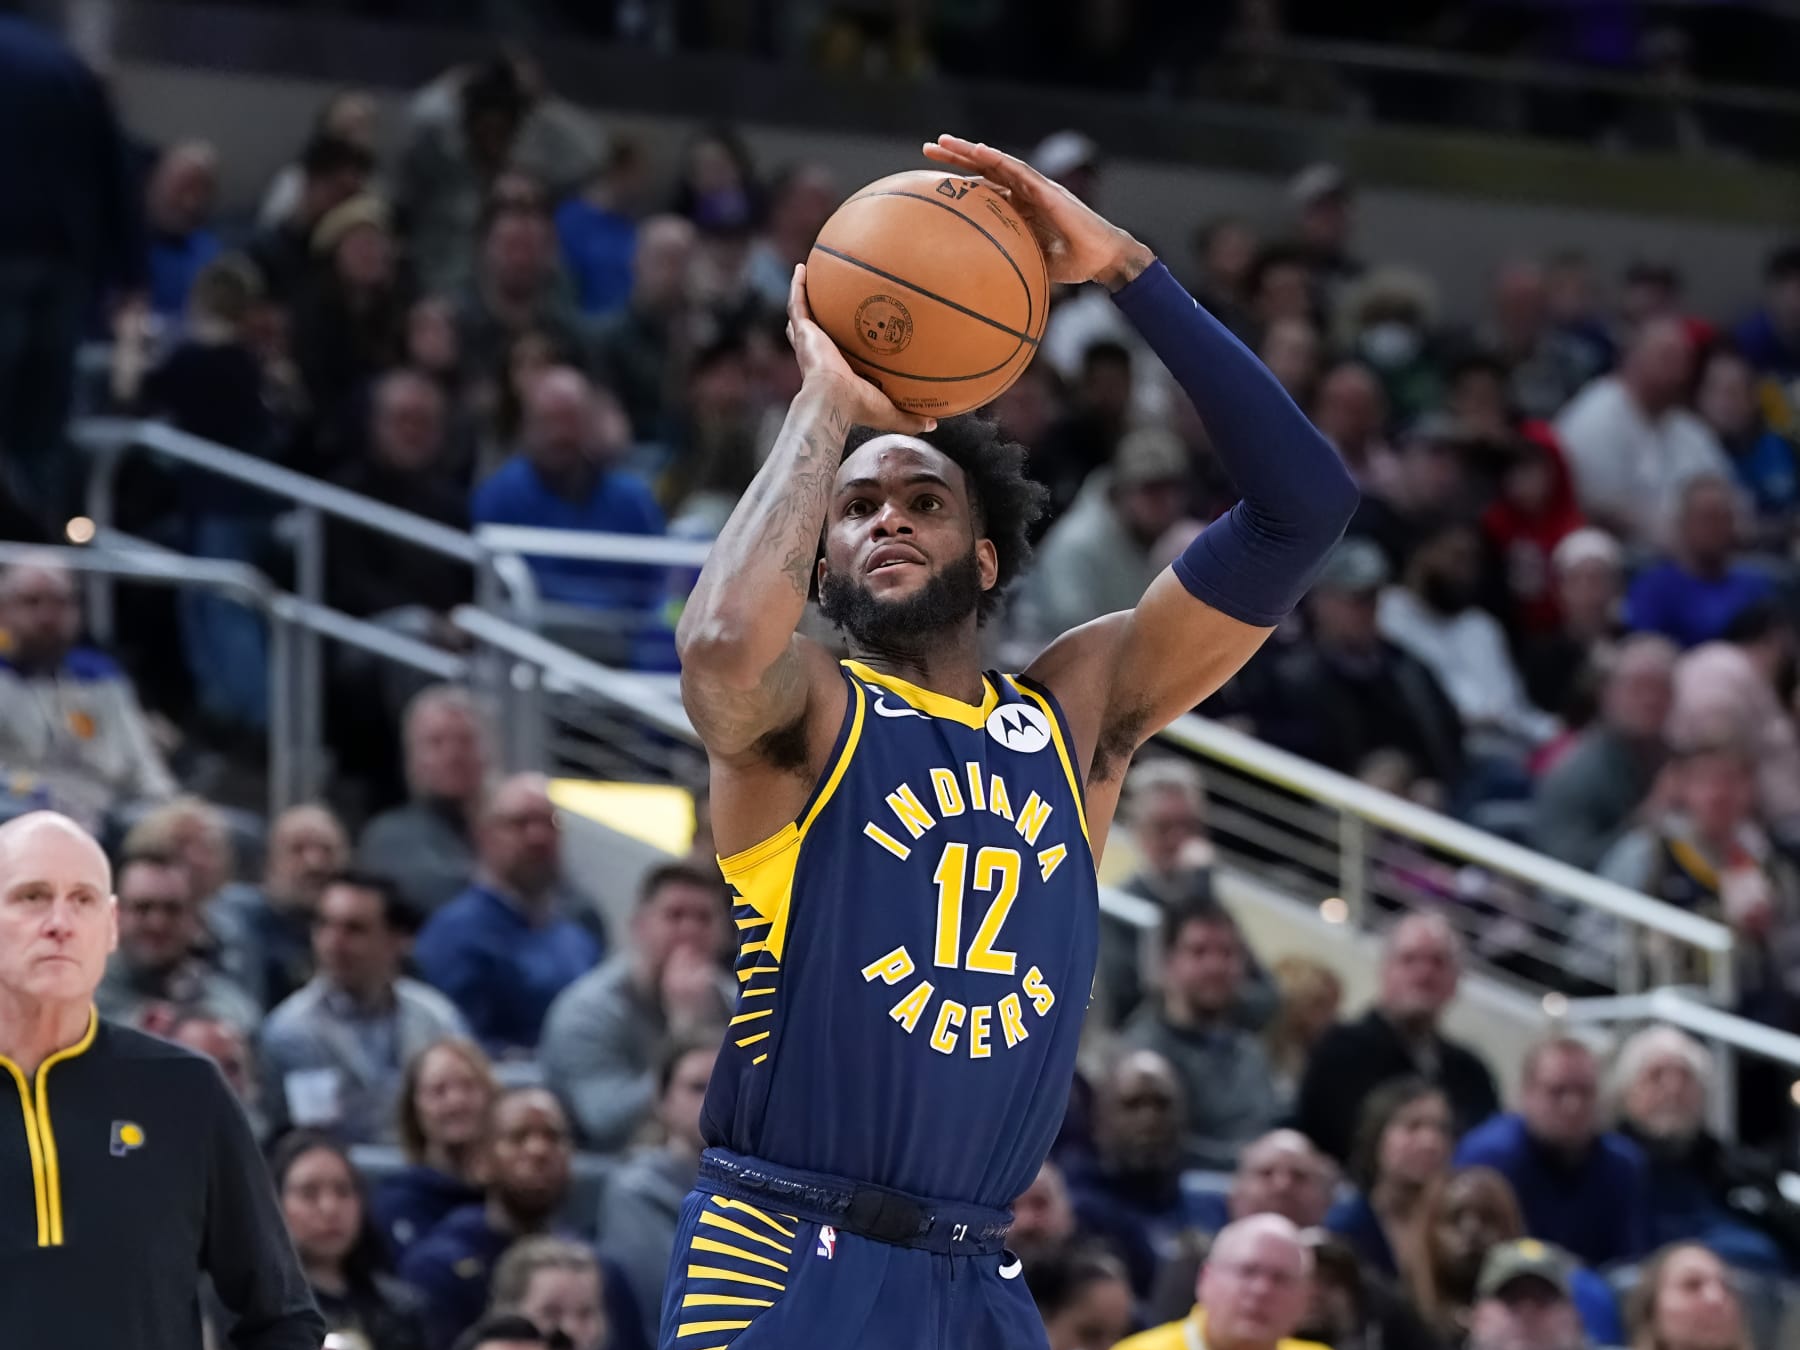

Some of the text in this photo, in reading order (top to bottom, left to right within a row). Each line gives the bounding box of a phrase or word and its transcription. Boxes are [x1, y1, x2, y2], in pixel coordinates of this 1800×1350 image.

[863, 761, 1067, 883] INDIANA
[933, 842, 1021, 975] 12
[861, 945, 1055, 1058] PACERS
